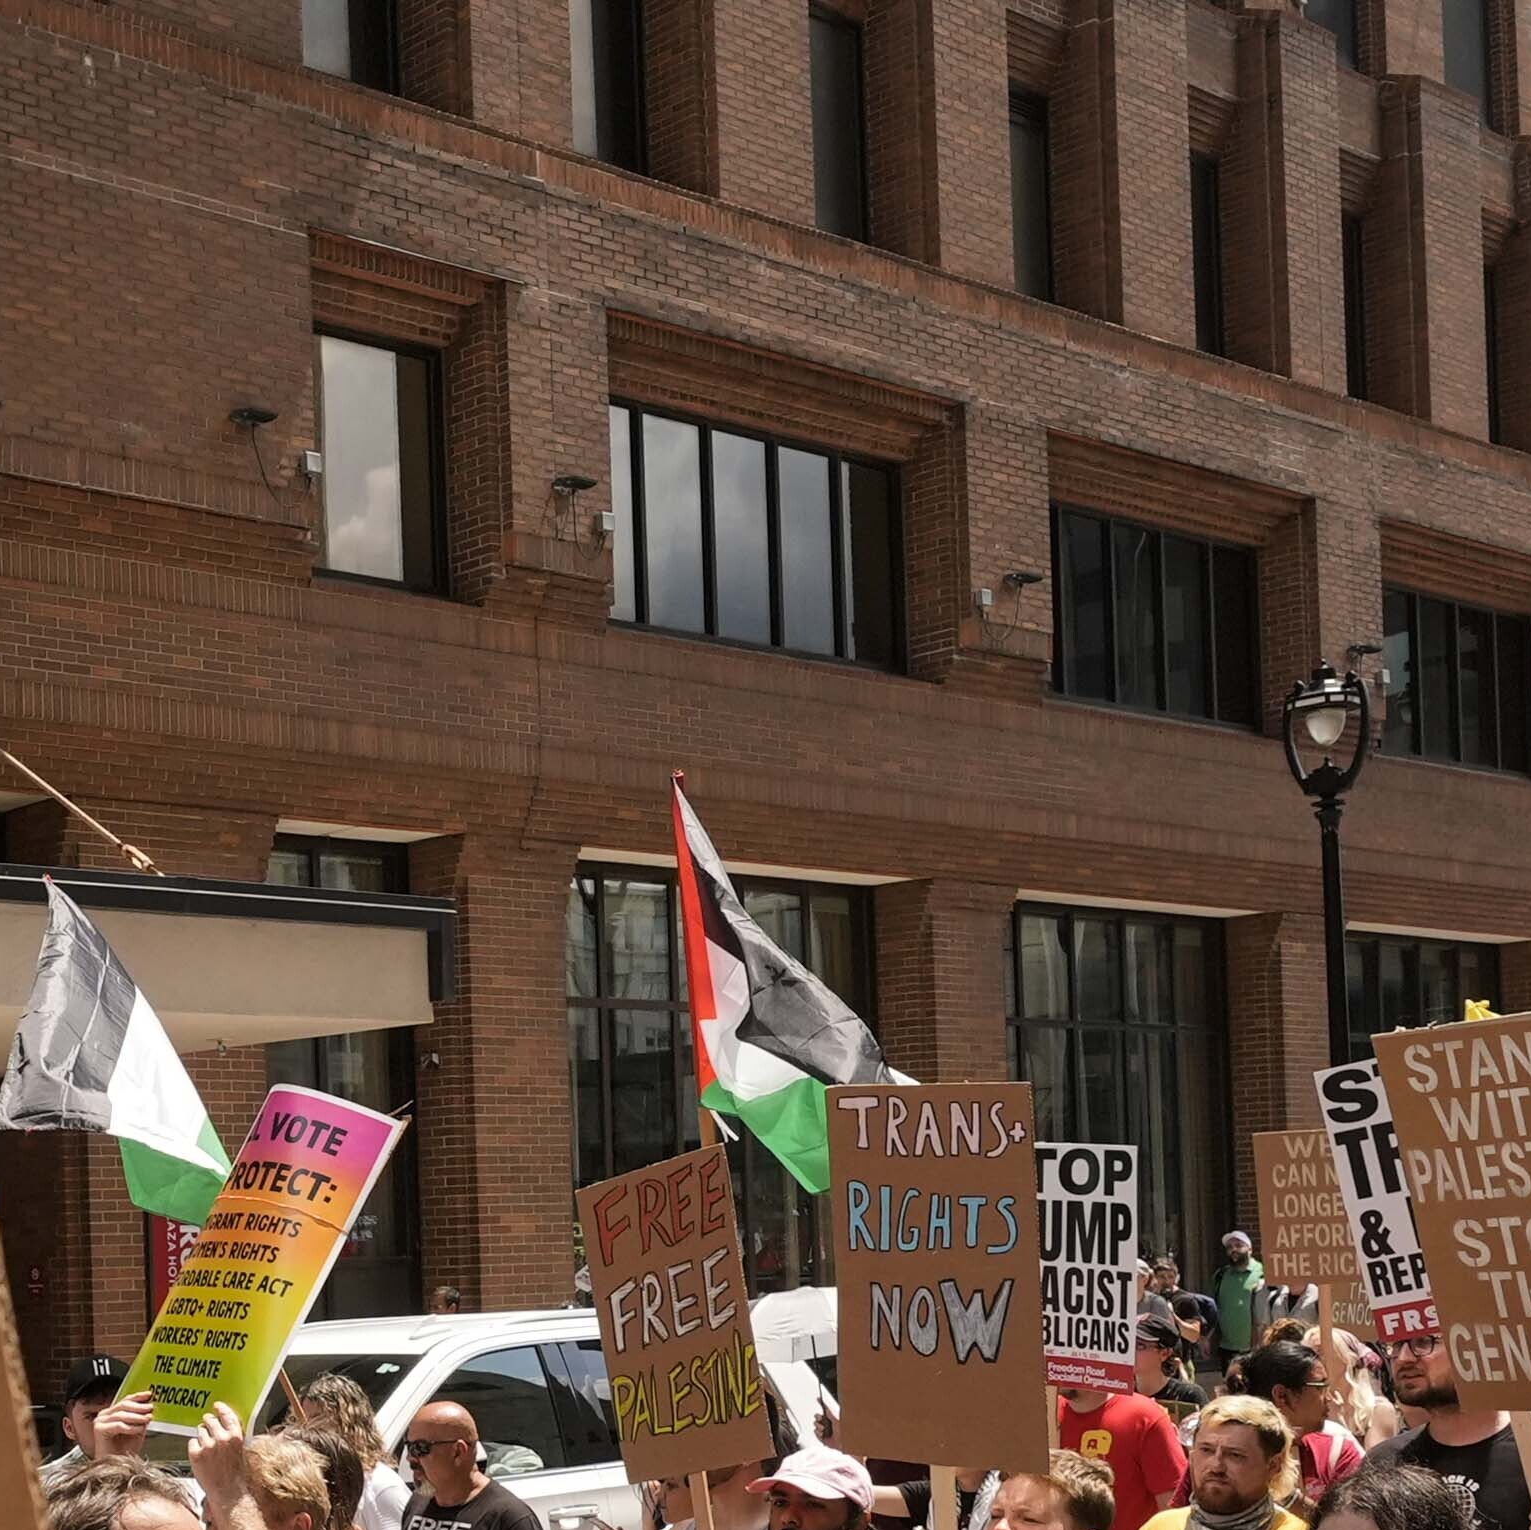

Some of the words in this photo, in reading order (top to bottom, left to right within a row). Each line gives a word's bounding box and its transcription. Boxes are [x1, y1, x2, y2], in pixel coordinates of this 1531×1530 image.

[269, 1110, 349, 1157] VOTE
[838, 1096, 1026, 1159] TRANS+
[1037, 1148, 1133, 1197] TOP
[1272, 1162, 1317, 1188] CAN
[1325, 1162, 1339, 1187] N
[593, 1152, 727, 1267] FREE
[847, 1180, 1020, 1255] RIGHTS
[1272, 1193, 1349, 1218] LONGE
[243, 1212, 302, 1238] RIGHTS
[1039, 1199, 1132, 1267] UMP
[1359, 1208, 1396, 1259] &
[227, 1241, 281, 1264] RIGHTS
[1270, 1253, 1313, 1277] THE
[1319, 1253, 1362, 1277] RIC
[221, 1270, 256, 1290] CARE
[257, 1275, 294, 1298] ACT
[1041, 1265, 1133, 1320] ACIST
[1349, 1281, 1368, 1301] TH
[166, 1296, 205, 1318] LGBTQ+
[205, 1299, 250, 1321] RIGHTS
[608, 1247, 737, 1356] FREE
[1331, 1302, 1376, 1326] GENOC
[869, 1277, 1014, 1365] NOW
[1043, 1314, 1130, 1355] BLICANS
[1381, 1308, 1440, 1336] FRS
[151, 1326, 203, 1347] WORKERS'
[204, 1328, 249, 1351] RIGHTS
[154, 1354, 174, 1375] THE
[175, 1357, 222, 1380] CLIMATE
[1085, 1365, 1105, 1377] Road
[148, 1383, 212, 1410] DEMOCRACY
[611, 1328, 761, 1444] PALESTINE
